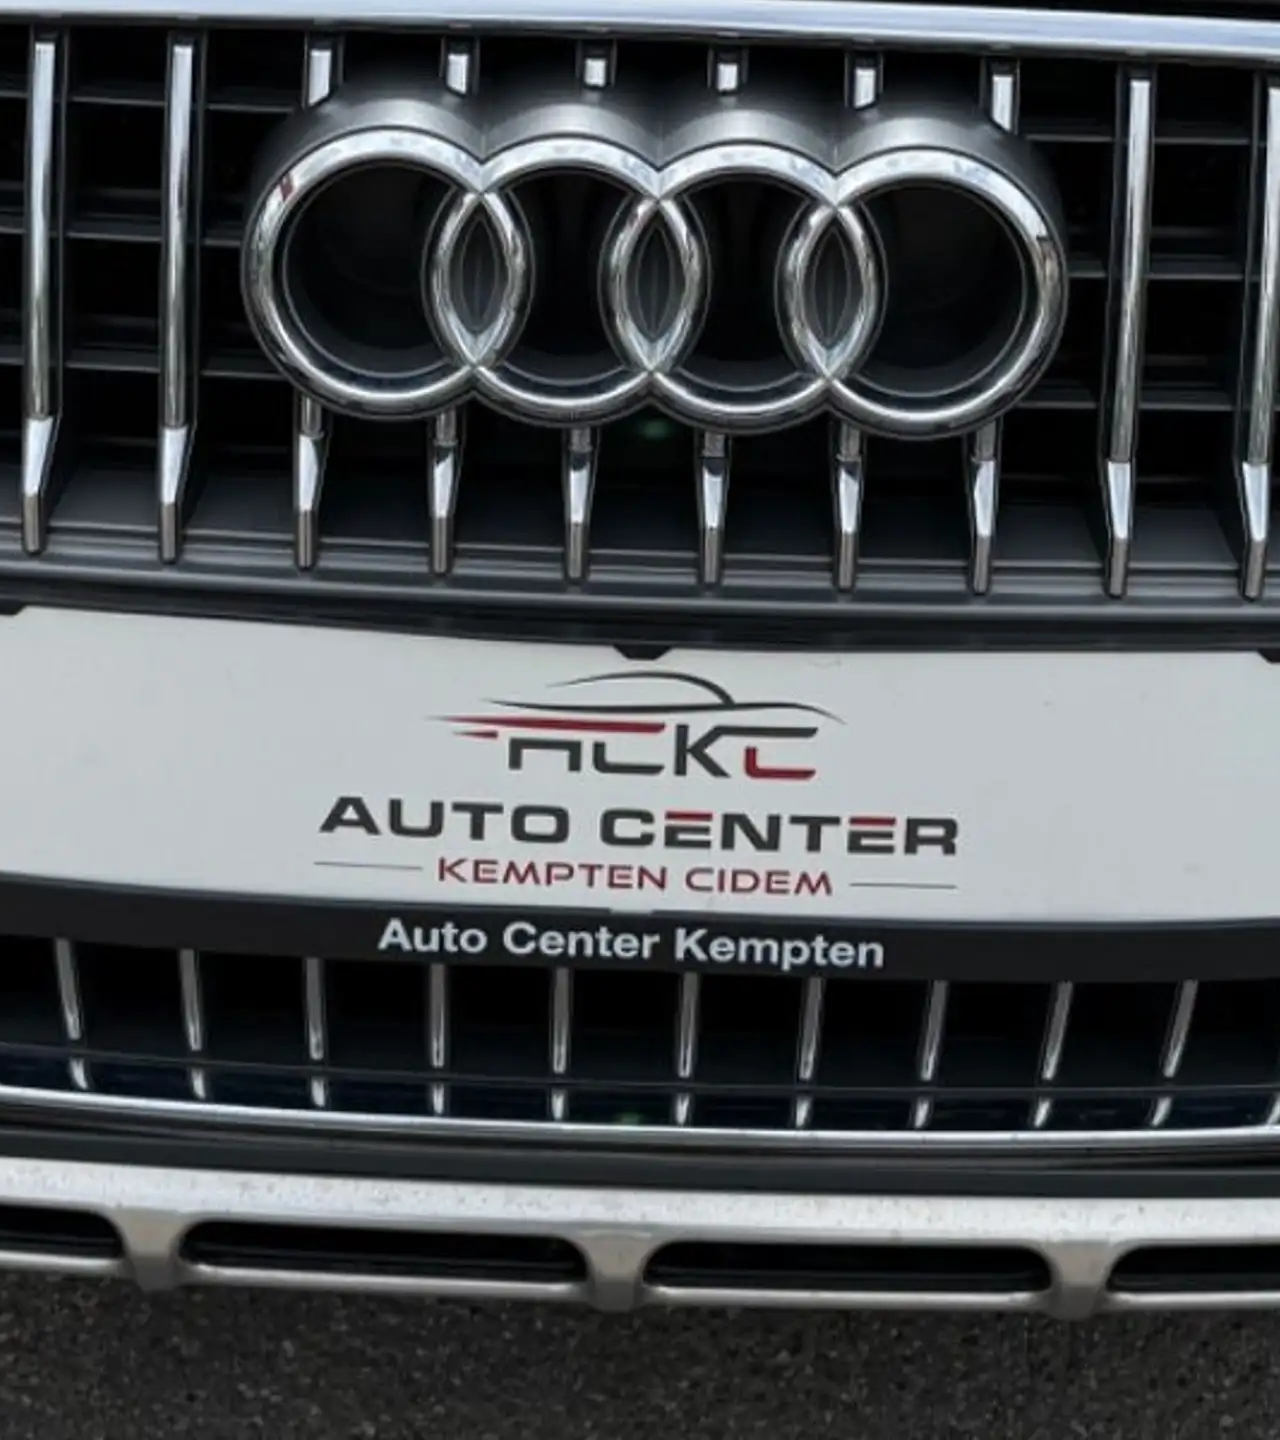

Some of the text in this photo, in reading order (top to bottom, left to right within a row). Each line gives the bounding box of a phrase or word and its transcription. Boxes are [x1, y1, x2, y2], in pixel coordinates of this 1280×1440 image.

[319, 795, 959, 856] AUTO CENTER
[437, 856, 834, 897] KEMPTEN CIDEM
[377, 917, 886, 971] Auto Center Kempten
